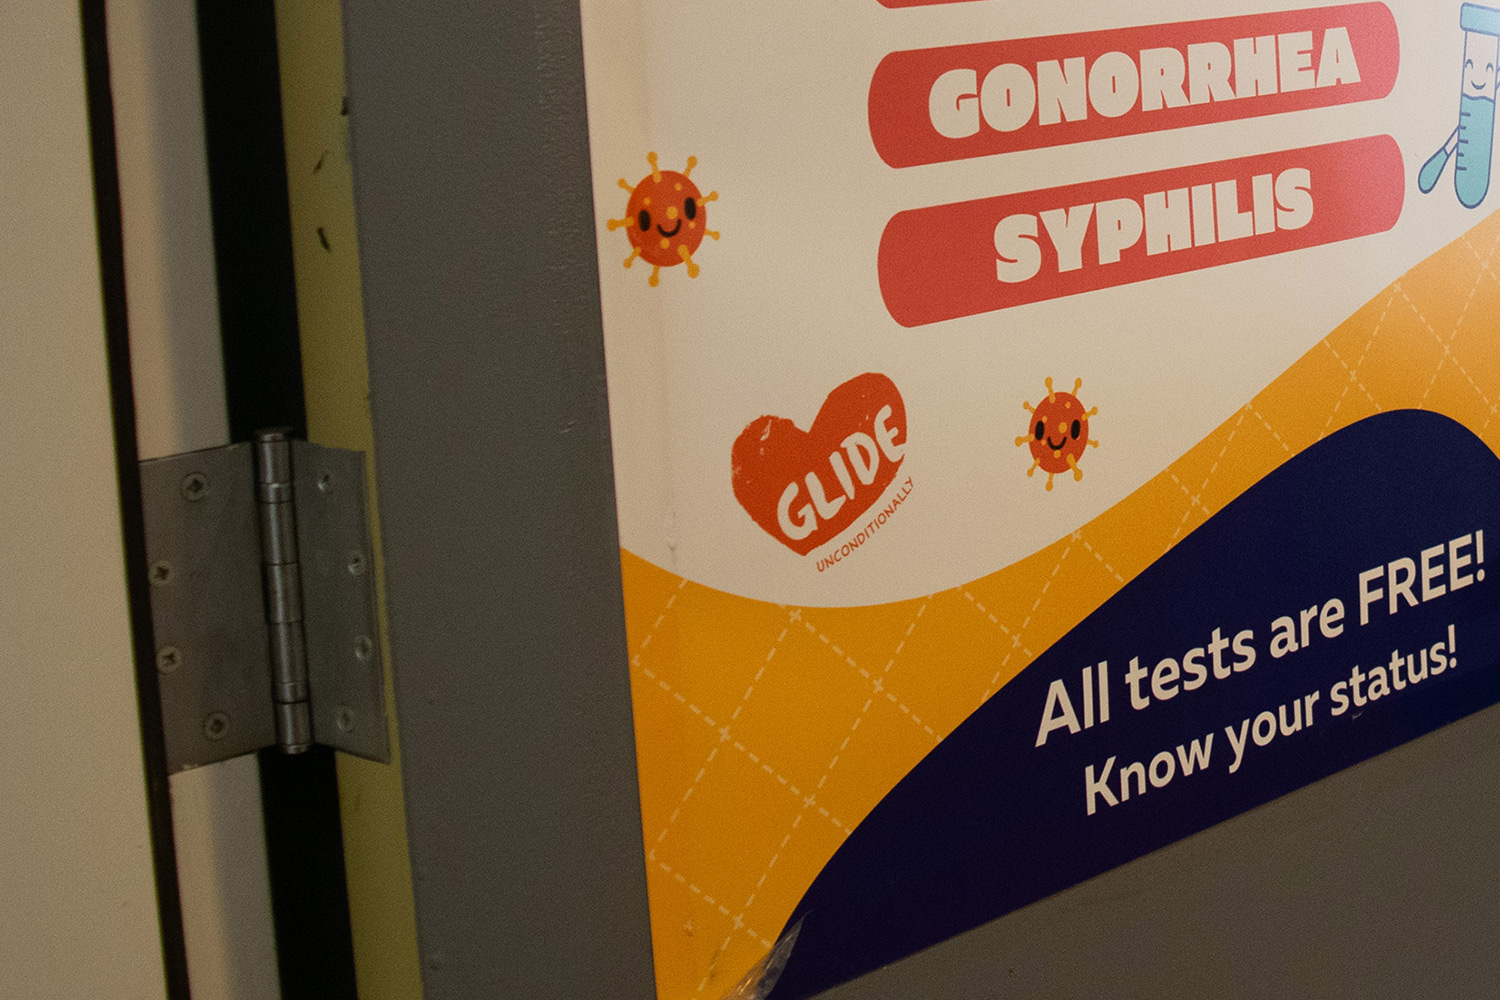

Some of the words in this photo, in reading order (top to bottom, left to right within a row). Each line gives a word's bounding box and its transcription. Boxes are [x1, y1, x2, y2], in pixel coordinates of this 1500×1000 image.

[928, 26, 1361, 139] GONORRHEA
[993, 167, 1314, 284] SYPHILIS
[777, 404, 905, 541] GLIDE
[816, 476, 915, 573] UNCONDITIONALLY
[1035, 661, 1110, 748] All
[1124, 627, 1257, 711] tests
[1270, 598, 1345, 658] are
[1358, 530, 1487, 627] FREE!
[1084, 732, 1215, 817] Know
[1225, 690, 1320, 773] your
[1330, 624, 1458, 717] status!
